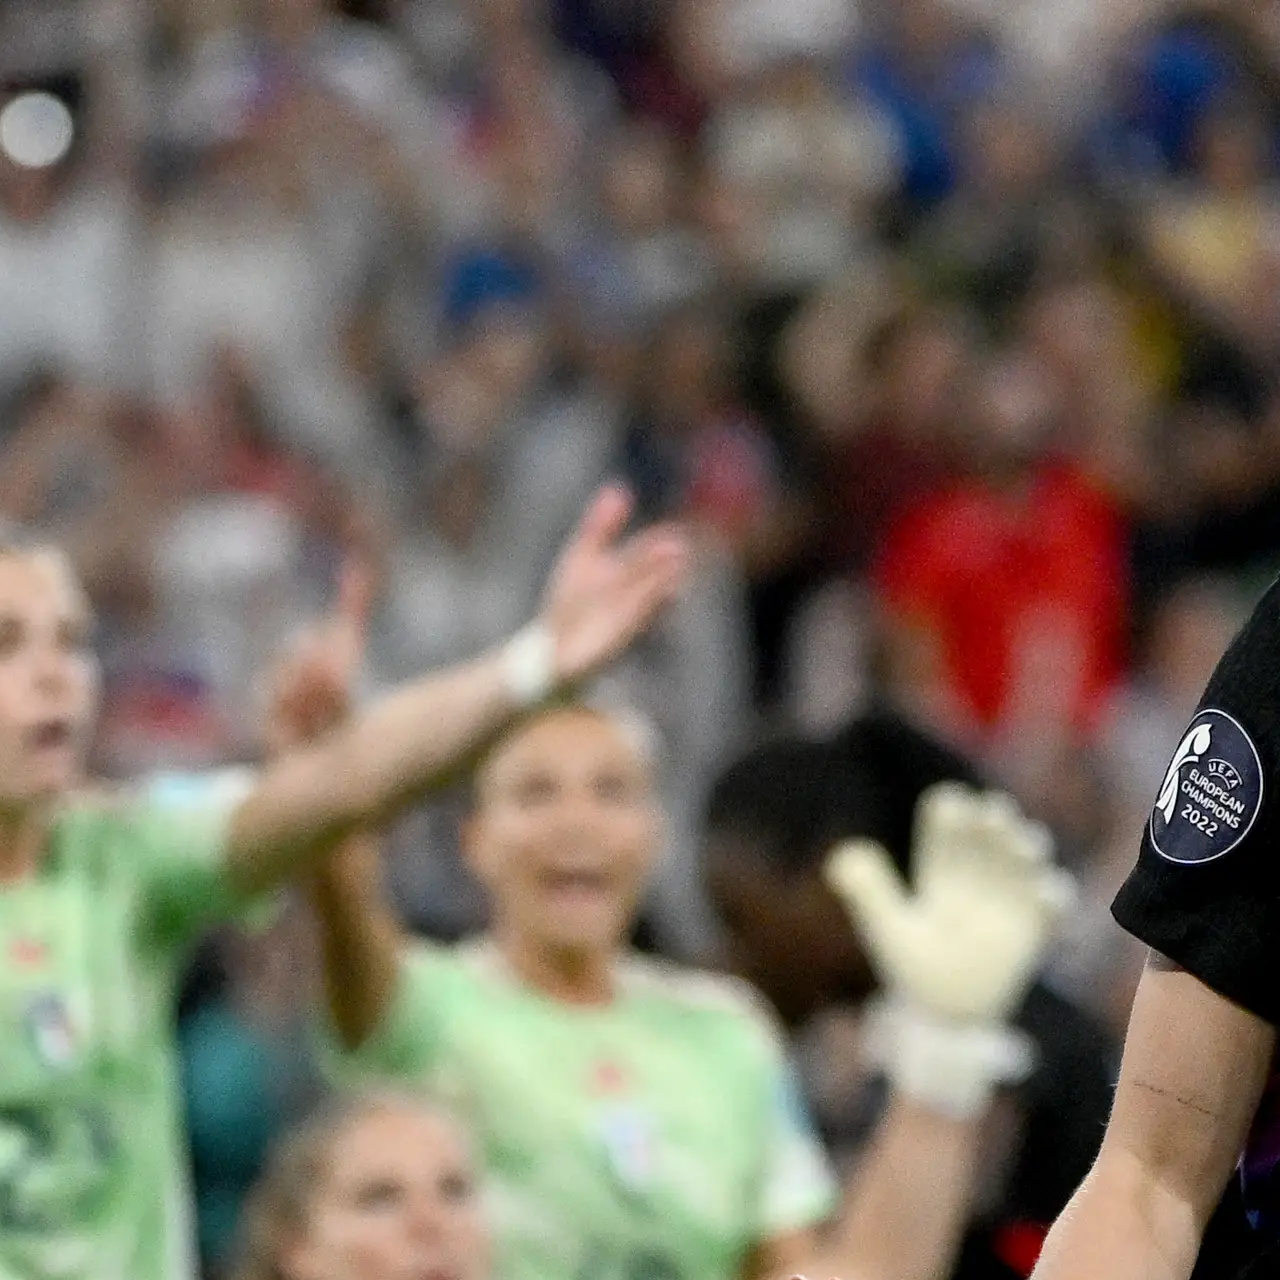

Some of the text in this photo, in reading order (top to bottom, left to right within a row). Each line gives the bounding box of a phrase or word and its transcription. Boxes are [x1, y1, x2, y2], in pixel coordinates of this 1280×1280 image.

[1188, 768, 1245, 814] EUROPEAN
[1208, 762, 1238, 789] UEFA
[1181, 780, 1241, 829] CHAMPIONS
[1181, 804, 1219, 837] 2022
